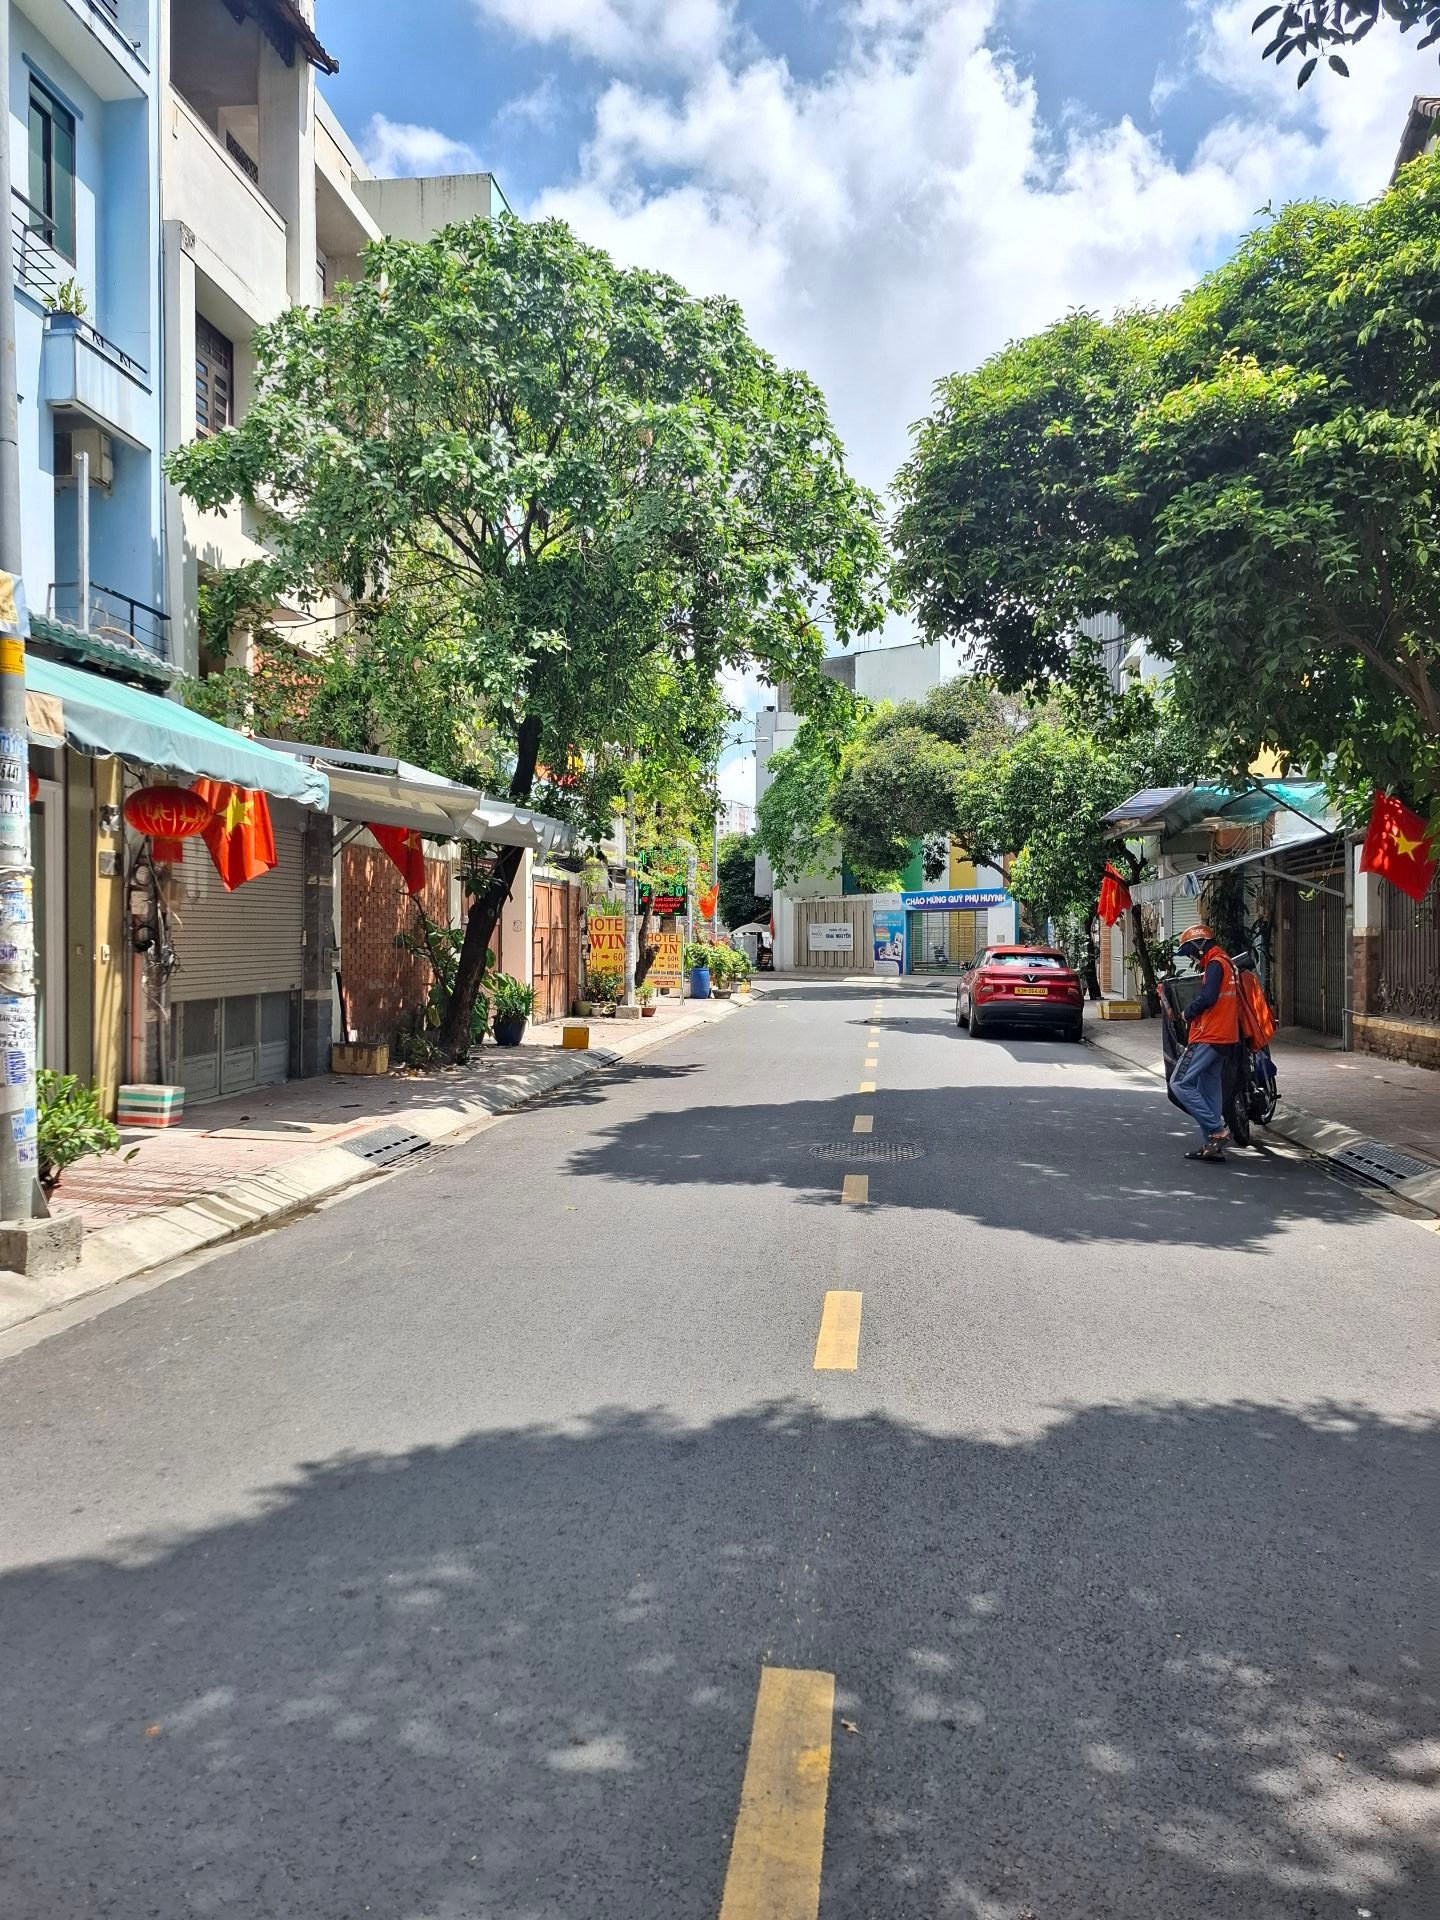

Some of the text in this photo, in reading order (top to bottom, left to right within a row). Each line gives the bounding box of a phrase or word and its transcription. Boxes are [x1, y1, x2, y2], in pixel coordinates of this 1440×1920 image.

[980, 894, 1006, 902] HUYNH
[588, 918, 623, 932] HOTE
[647, 934, 681, 942] HOTEL
